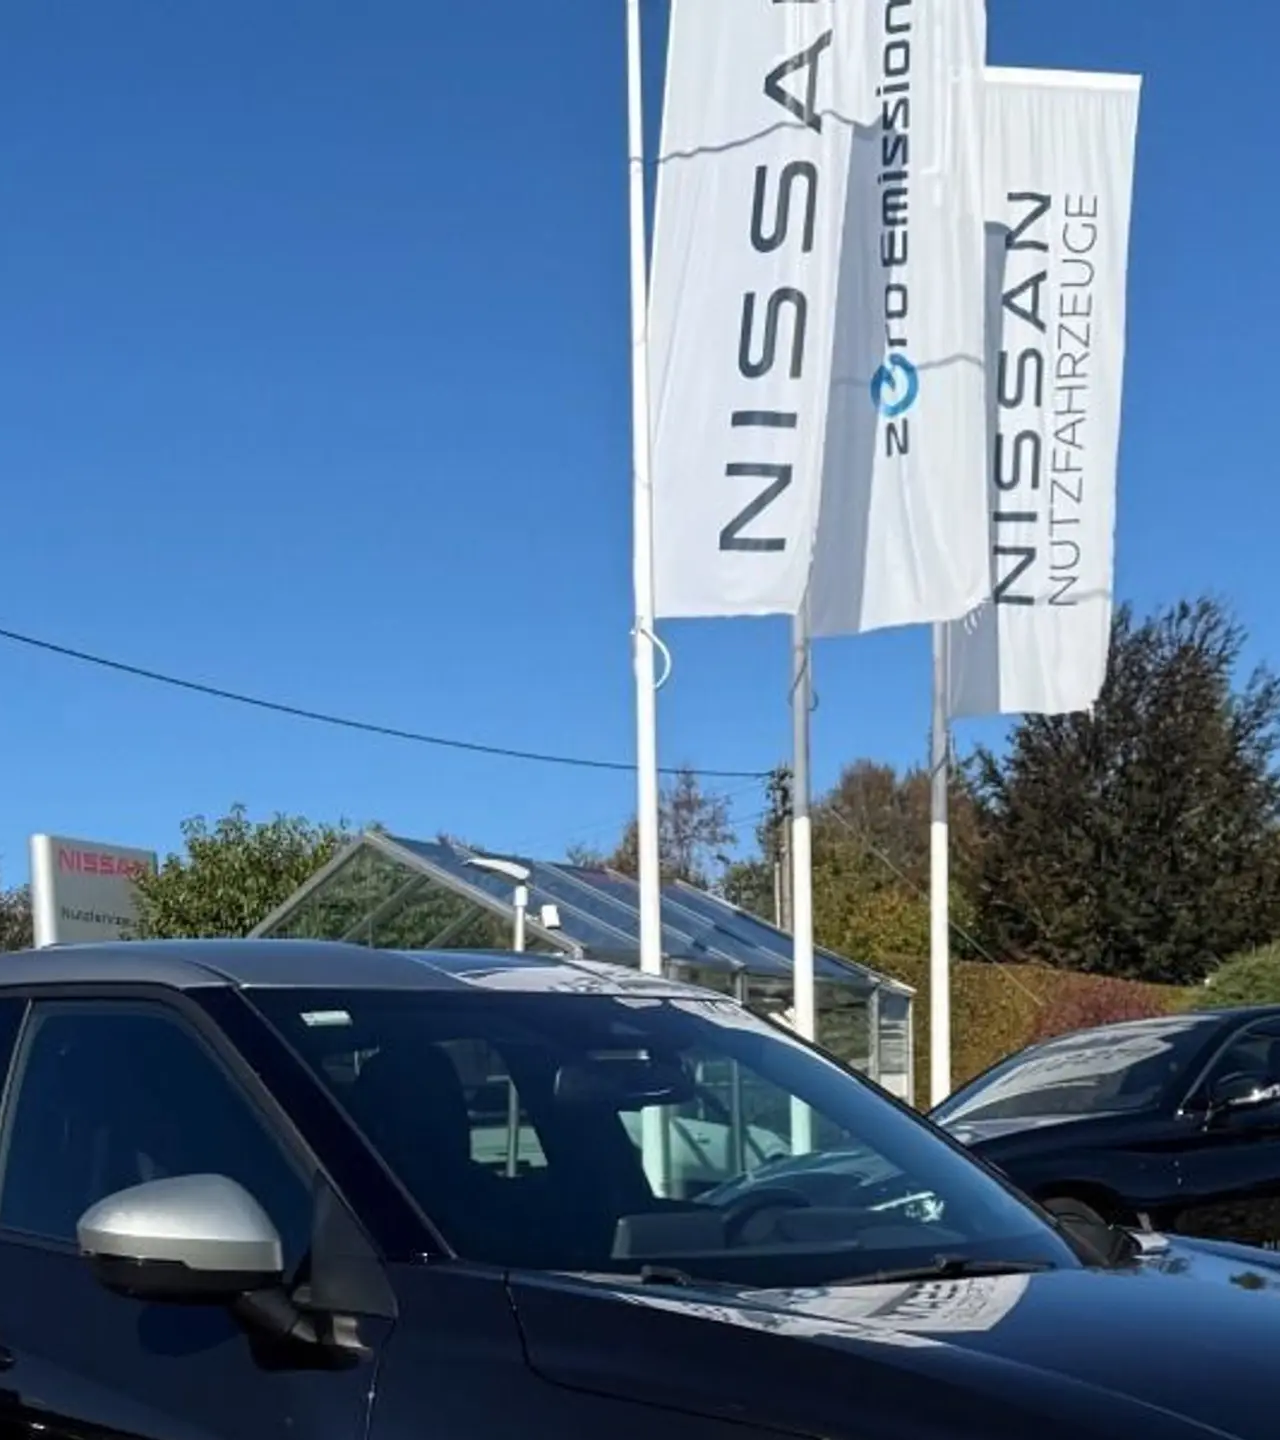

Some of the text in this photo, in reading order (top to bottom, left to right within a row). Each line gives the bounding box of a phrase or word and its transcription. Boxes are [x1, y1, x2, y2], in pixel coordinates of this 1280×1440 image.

[719, 0, 833, 552] NISSA
[876, 0, 912, 267] Emission
[993, 190, 1053, 607] NISSAN
[1048, 193, 1099, 606] NUTZFAHRZEUGE
